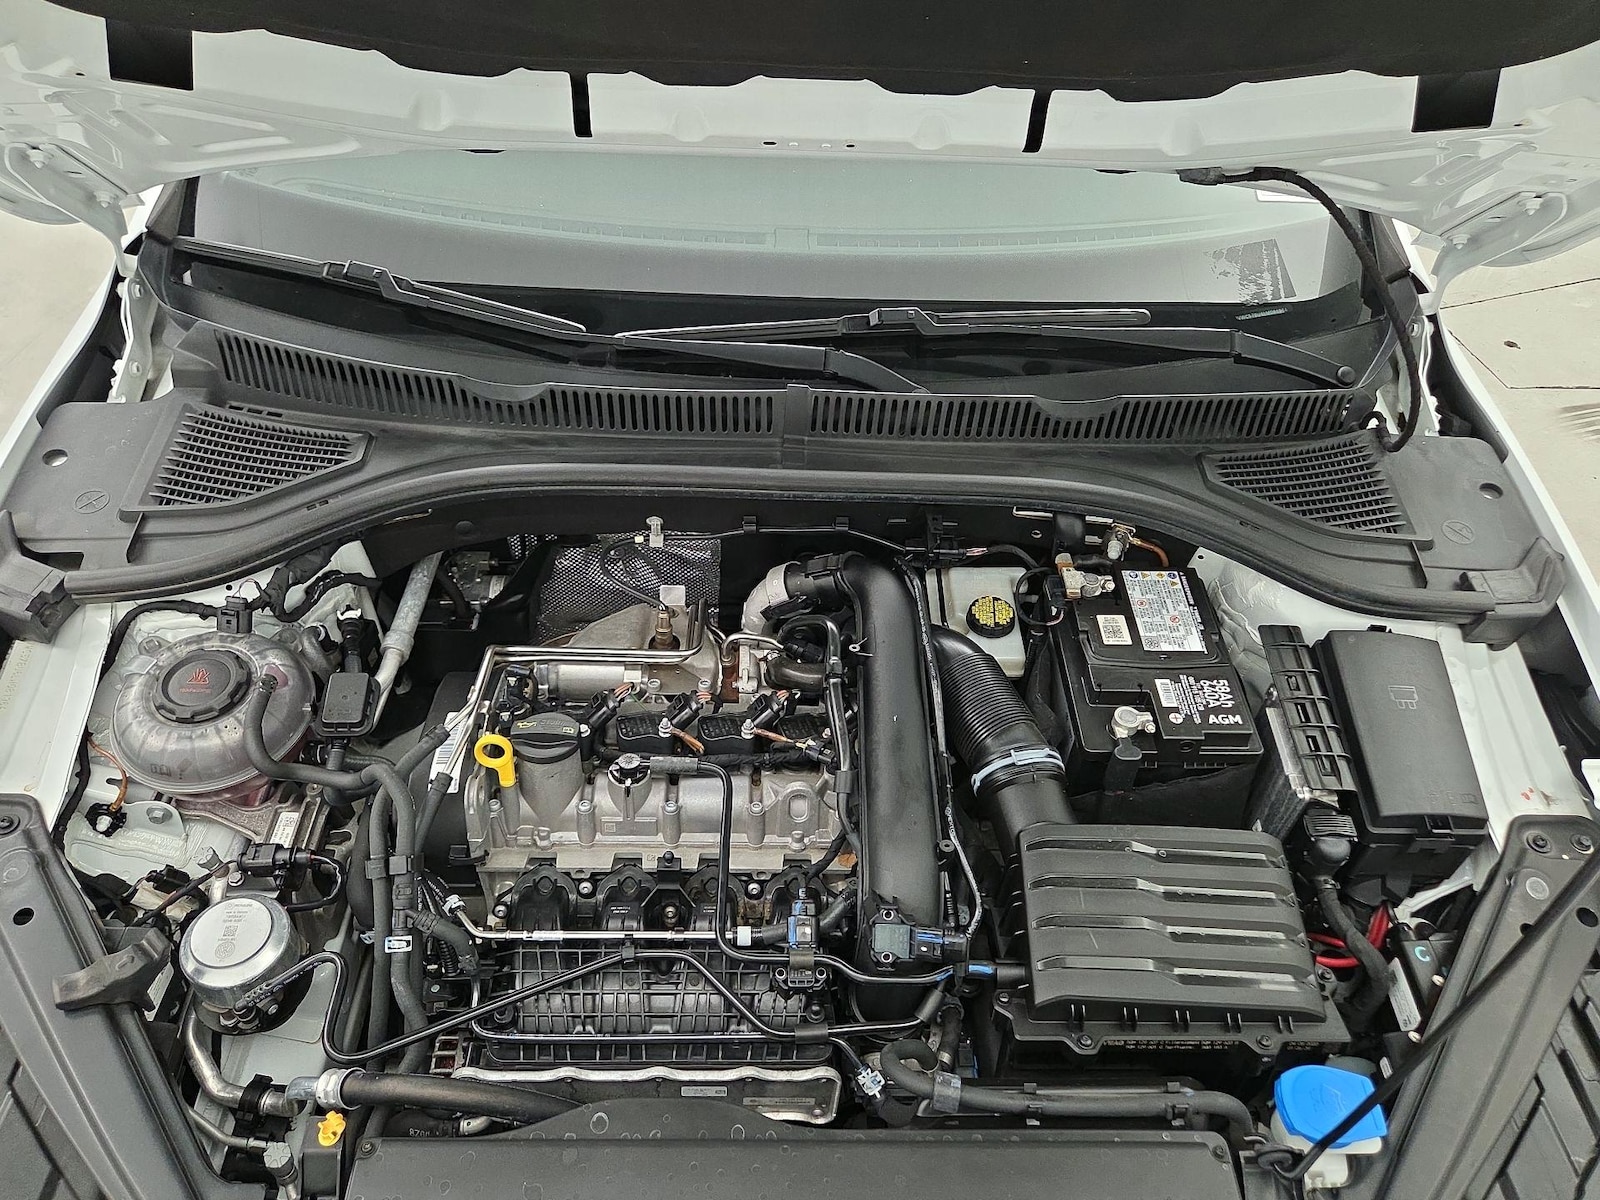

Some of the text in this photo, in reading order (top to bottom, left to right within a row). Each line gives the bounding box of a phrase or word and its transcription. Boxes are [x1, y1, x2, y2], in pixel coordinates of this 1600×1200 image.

[1200, 679, 1221, 708] 640A
[1212, 679, 1235, 708] 58Ah
[1209, 714, 1243, 725] AGM
